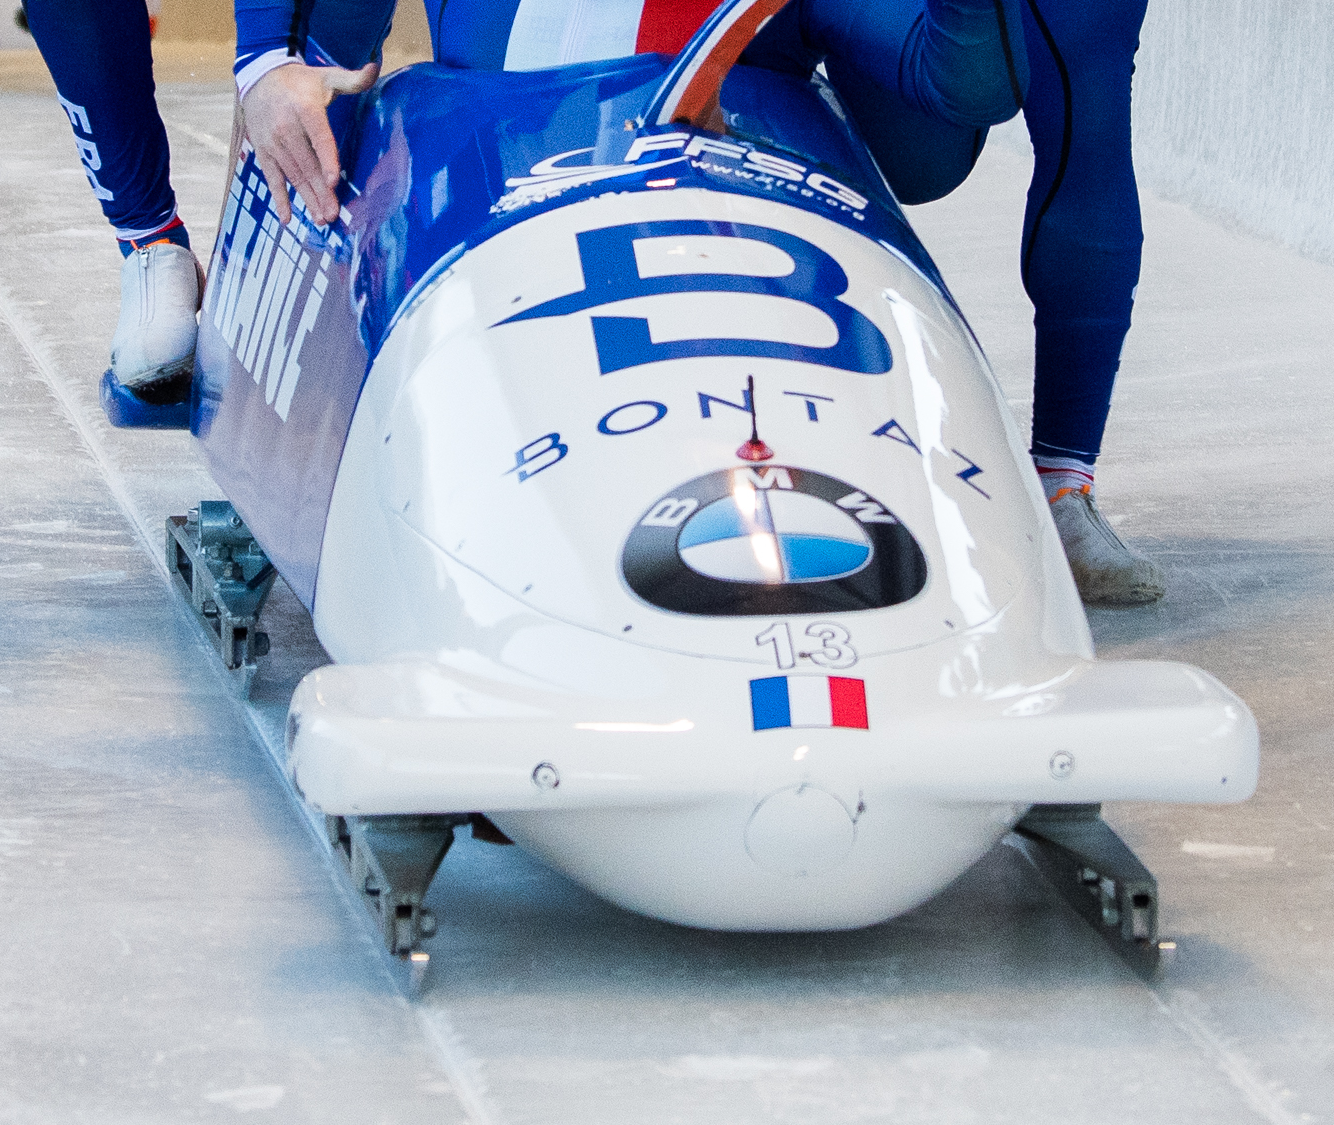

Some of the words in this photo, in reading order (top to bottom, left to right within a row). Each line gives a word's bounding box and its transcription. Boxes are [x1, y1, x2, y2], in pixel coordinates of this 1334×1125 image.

[623, 132, 868, 210] FFSG
[486, 218, 893, 376] B
[501, 388, 991, 501] BONTAZ
[754, 620, 859, 670] 13
